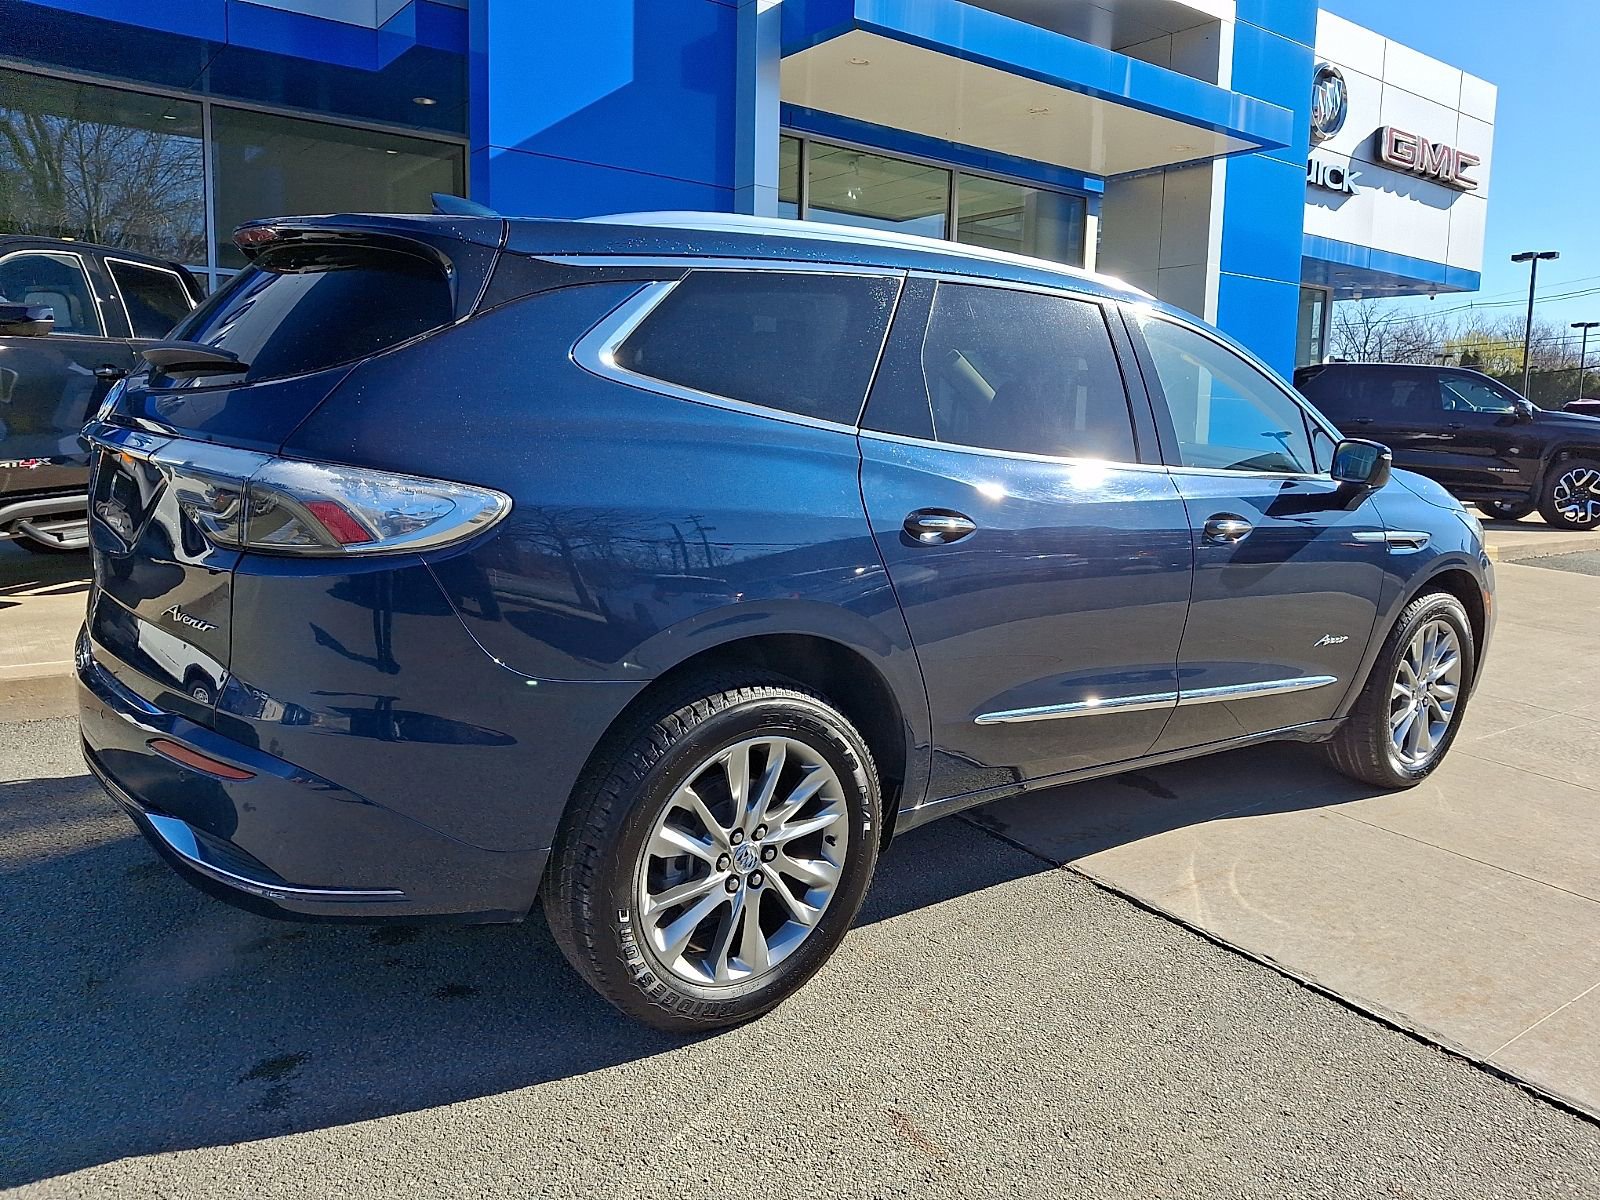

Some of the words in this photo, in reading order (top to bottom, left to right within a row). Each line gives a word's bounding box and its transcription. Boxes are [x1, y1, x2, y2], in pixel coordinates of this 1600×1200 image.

[1306, 159, 1362, 195] UICK
[1382, 126, 1480, 190] GMC
[160, 604, 219, 632] Avenir
[617, 908, 740, 1017] BRIDGESTONE
